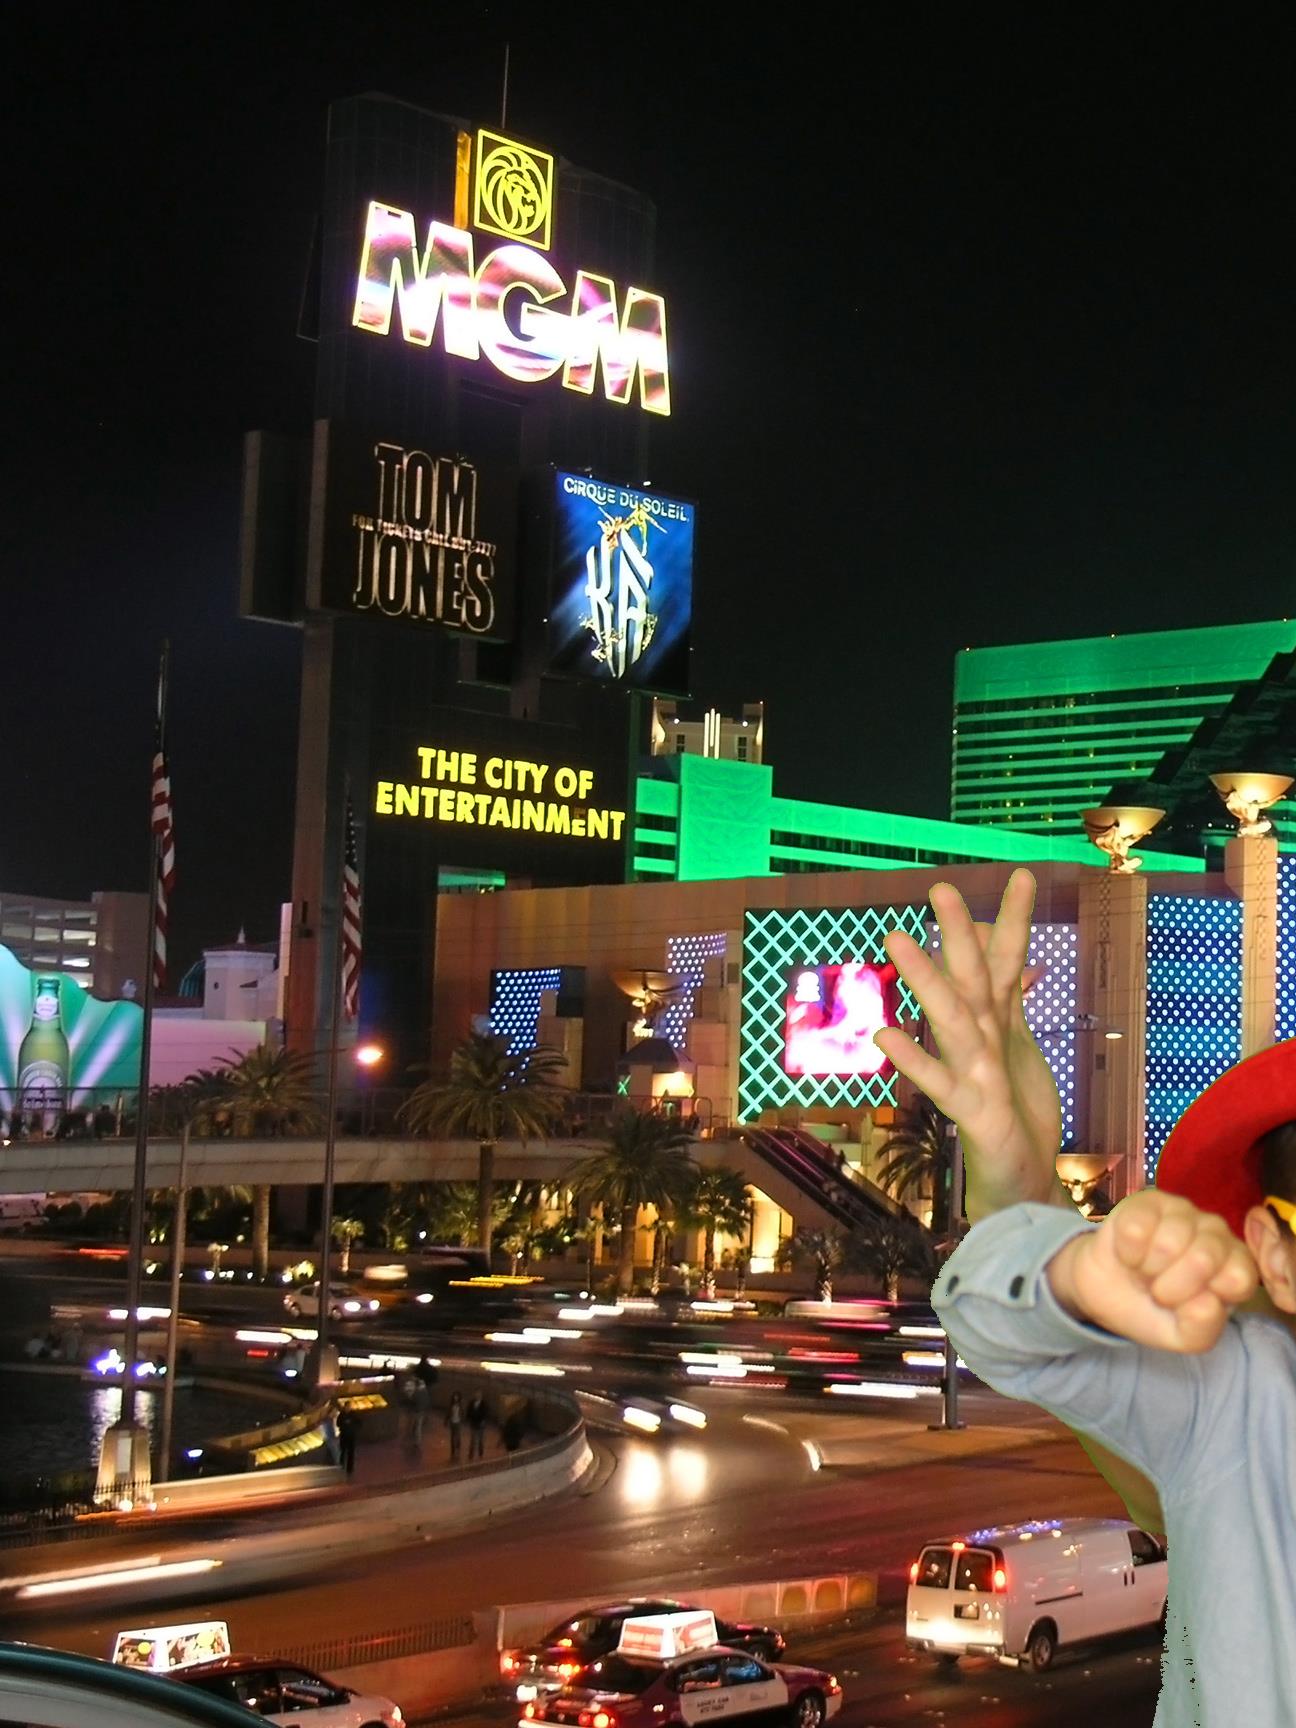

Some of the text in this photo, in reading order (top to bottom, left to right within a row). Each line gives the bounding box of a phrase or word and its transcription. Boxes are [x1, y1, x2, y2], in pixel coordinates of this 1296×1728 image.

[352, 201, 671, 416] MGM
[374, 442, 477, 538] TOM
[563, 477, 687, 521] CIRQUE DU SOLEIL
[353, 530, 495, 632] JONES
[375, 781, 626, 841] ENTERTAINMENT
[417, 746, 594, 800] THE CITY OF
